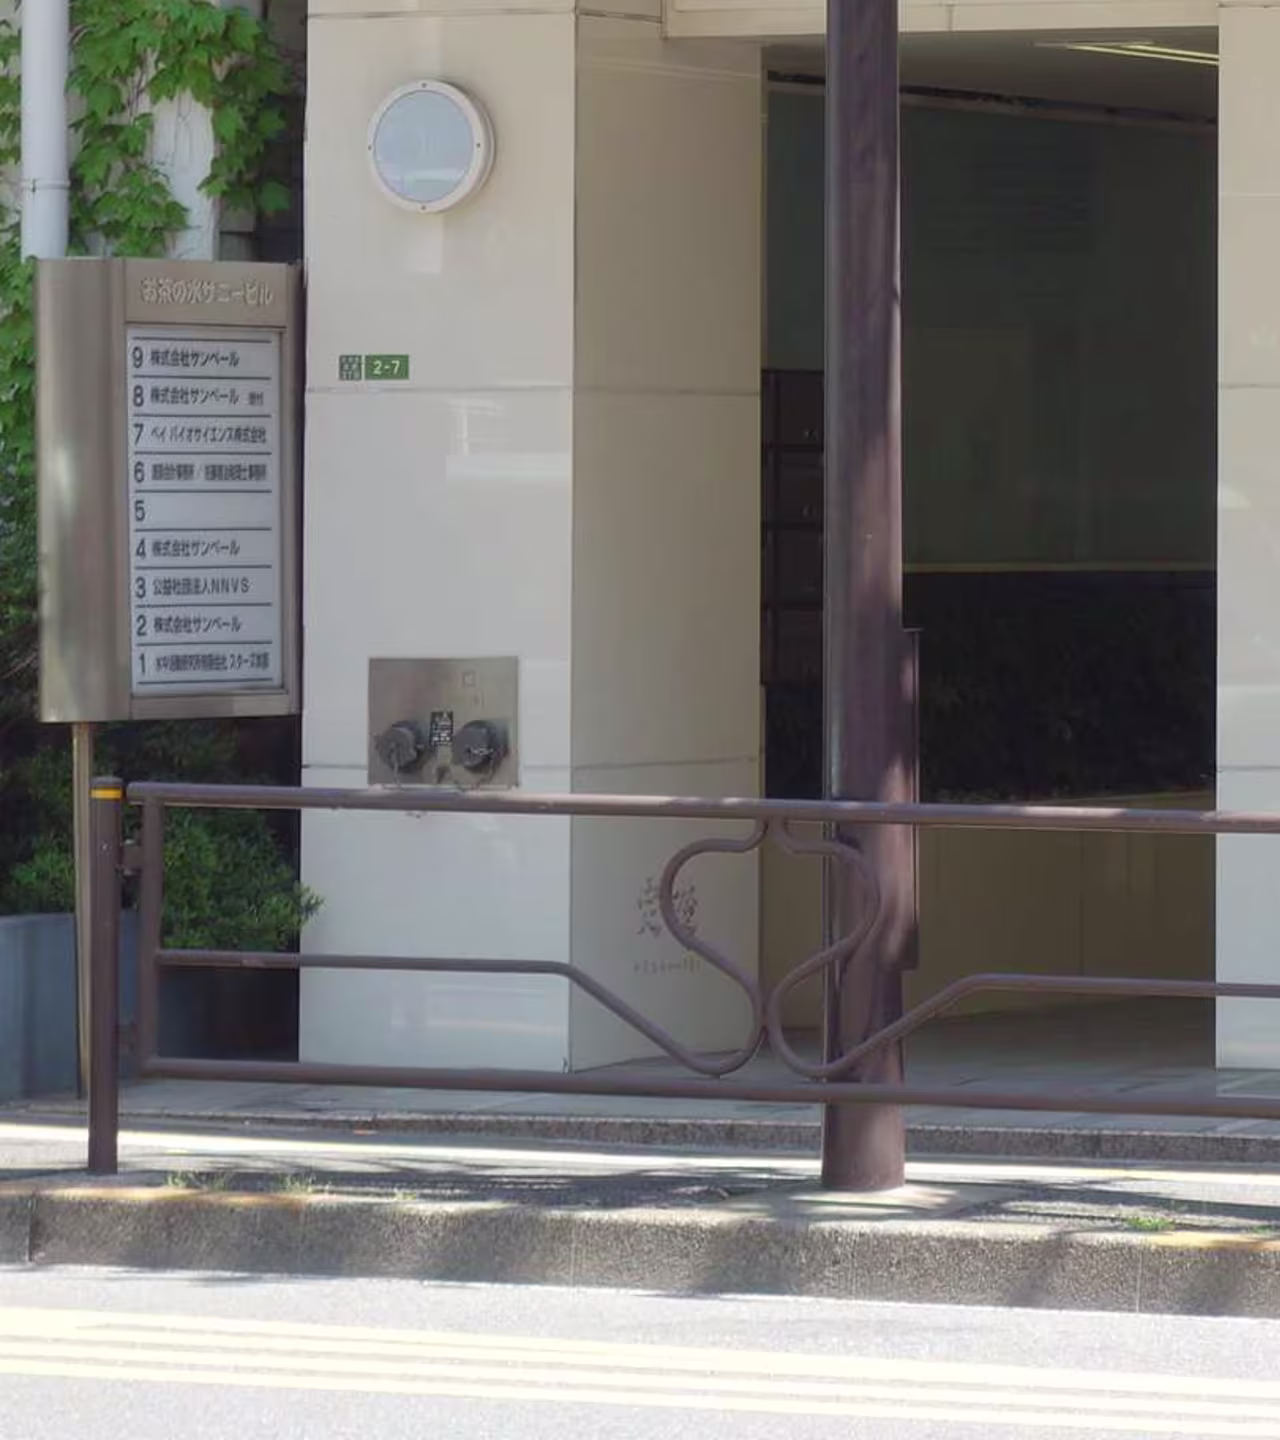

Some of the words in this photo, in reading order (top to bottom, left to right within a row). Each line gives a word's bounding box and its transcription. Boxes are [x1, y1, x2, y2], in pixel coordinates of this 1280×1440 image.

[140, 277, 273, 305] お茶の水サニービル
[132, 346, 143, 368] 9
[373, 360, 401, 375] 2-7
[133, 385, 144, 407] 8
[133, 423, 144, 445] 7
[134, 461, 145, 483] 6
[135, 500, 145, 522] 5
[135, 538, 147, 560] 4
[135, 576, 147, 599] 3
[136, 614, 148, 637] 2
[138, 653, 146, 675] 1
